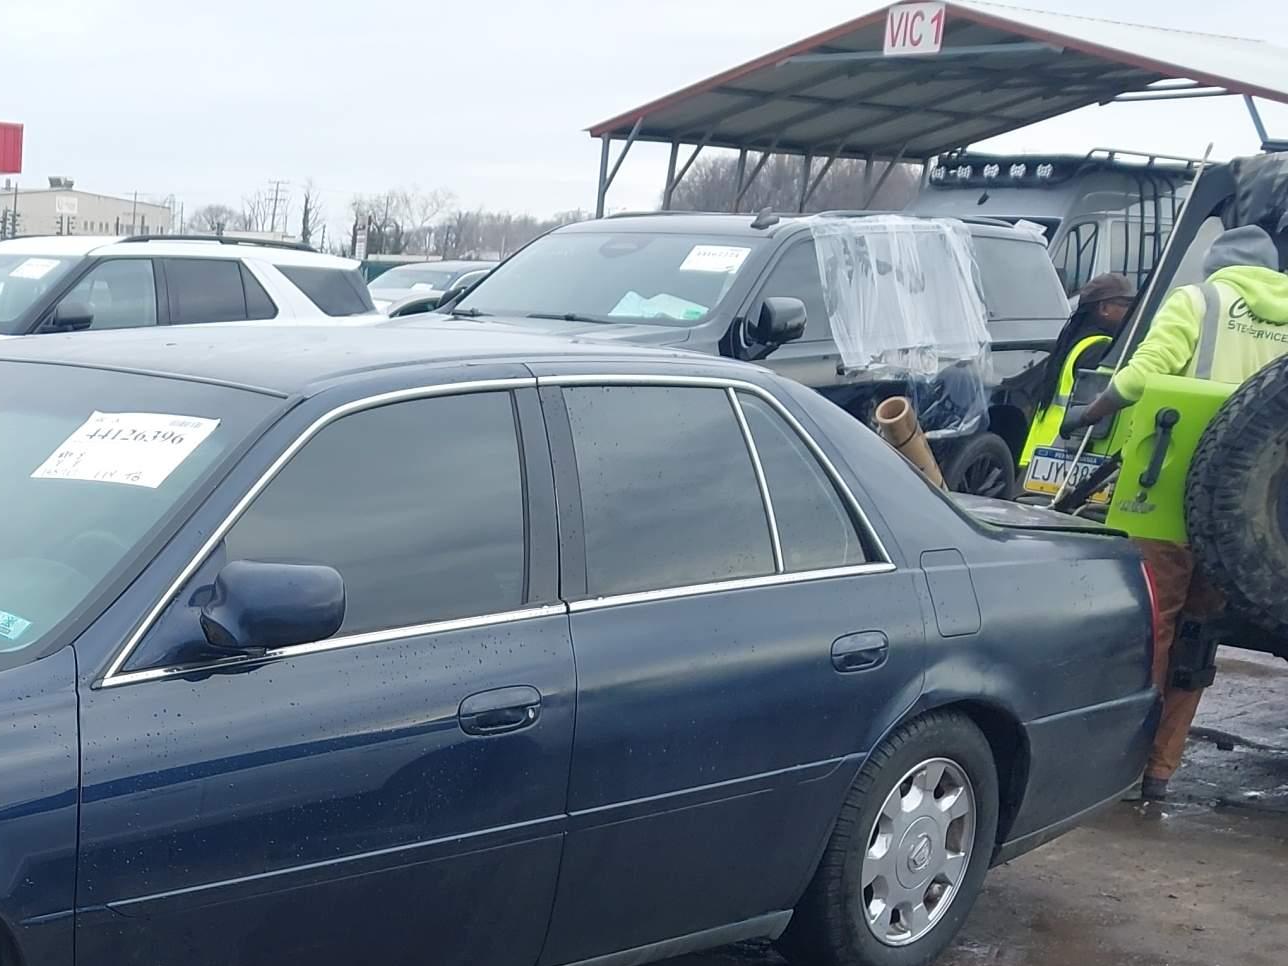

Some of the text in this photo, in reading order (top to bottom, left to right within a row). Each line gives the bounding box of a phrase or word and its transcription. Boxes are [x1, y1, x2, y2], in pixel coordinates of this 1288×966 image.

[890, 8, 943, 47] VIC 1
[86, 427, 185, 446] 44126396
[1031, 459, 1065, 483] LJY
